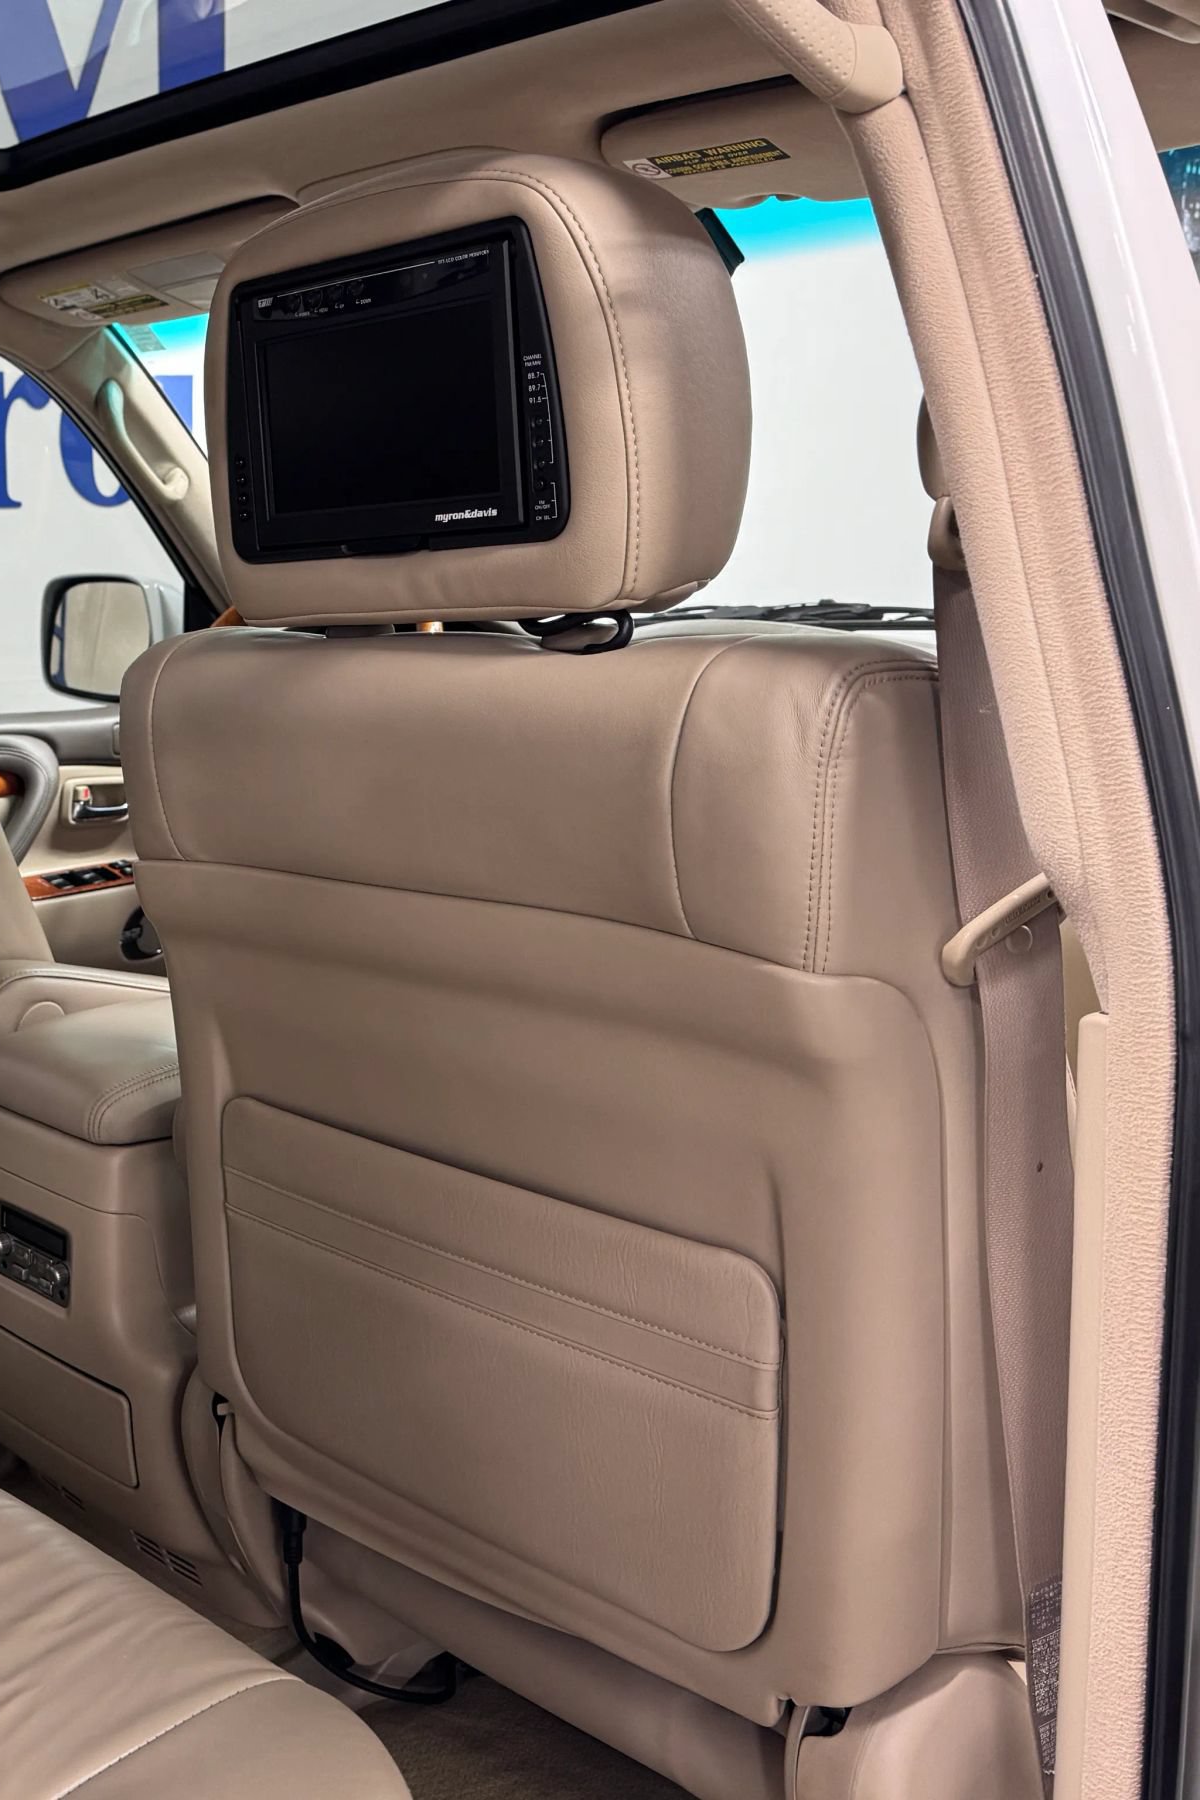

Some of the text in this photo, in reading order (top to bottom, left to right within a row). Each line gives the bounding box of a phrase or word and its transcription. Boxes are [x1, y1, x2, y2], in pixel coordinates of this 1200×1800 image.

[655, 152, 701, 165] AIRBAG
[704, 140, 768, 157] WARNING
[435, 508, 498, 522] myron&davis
